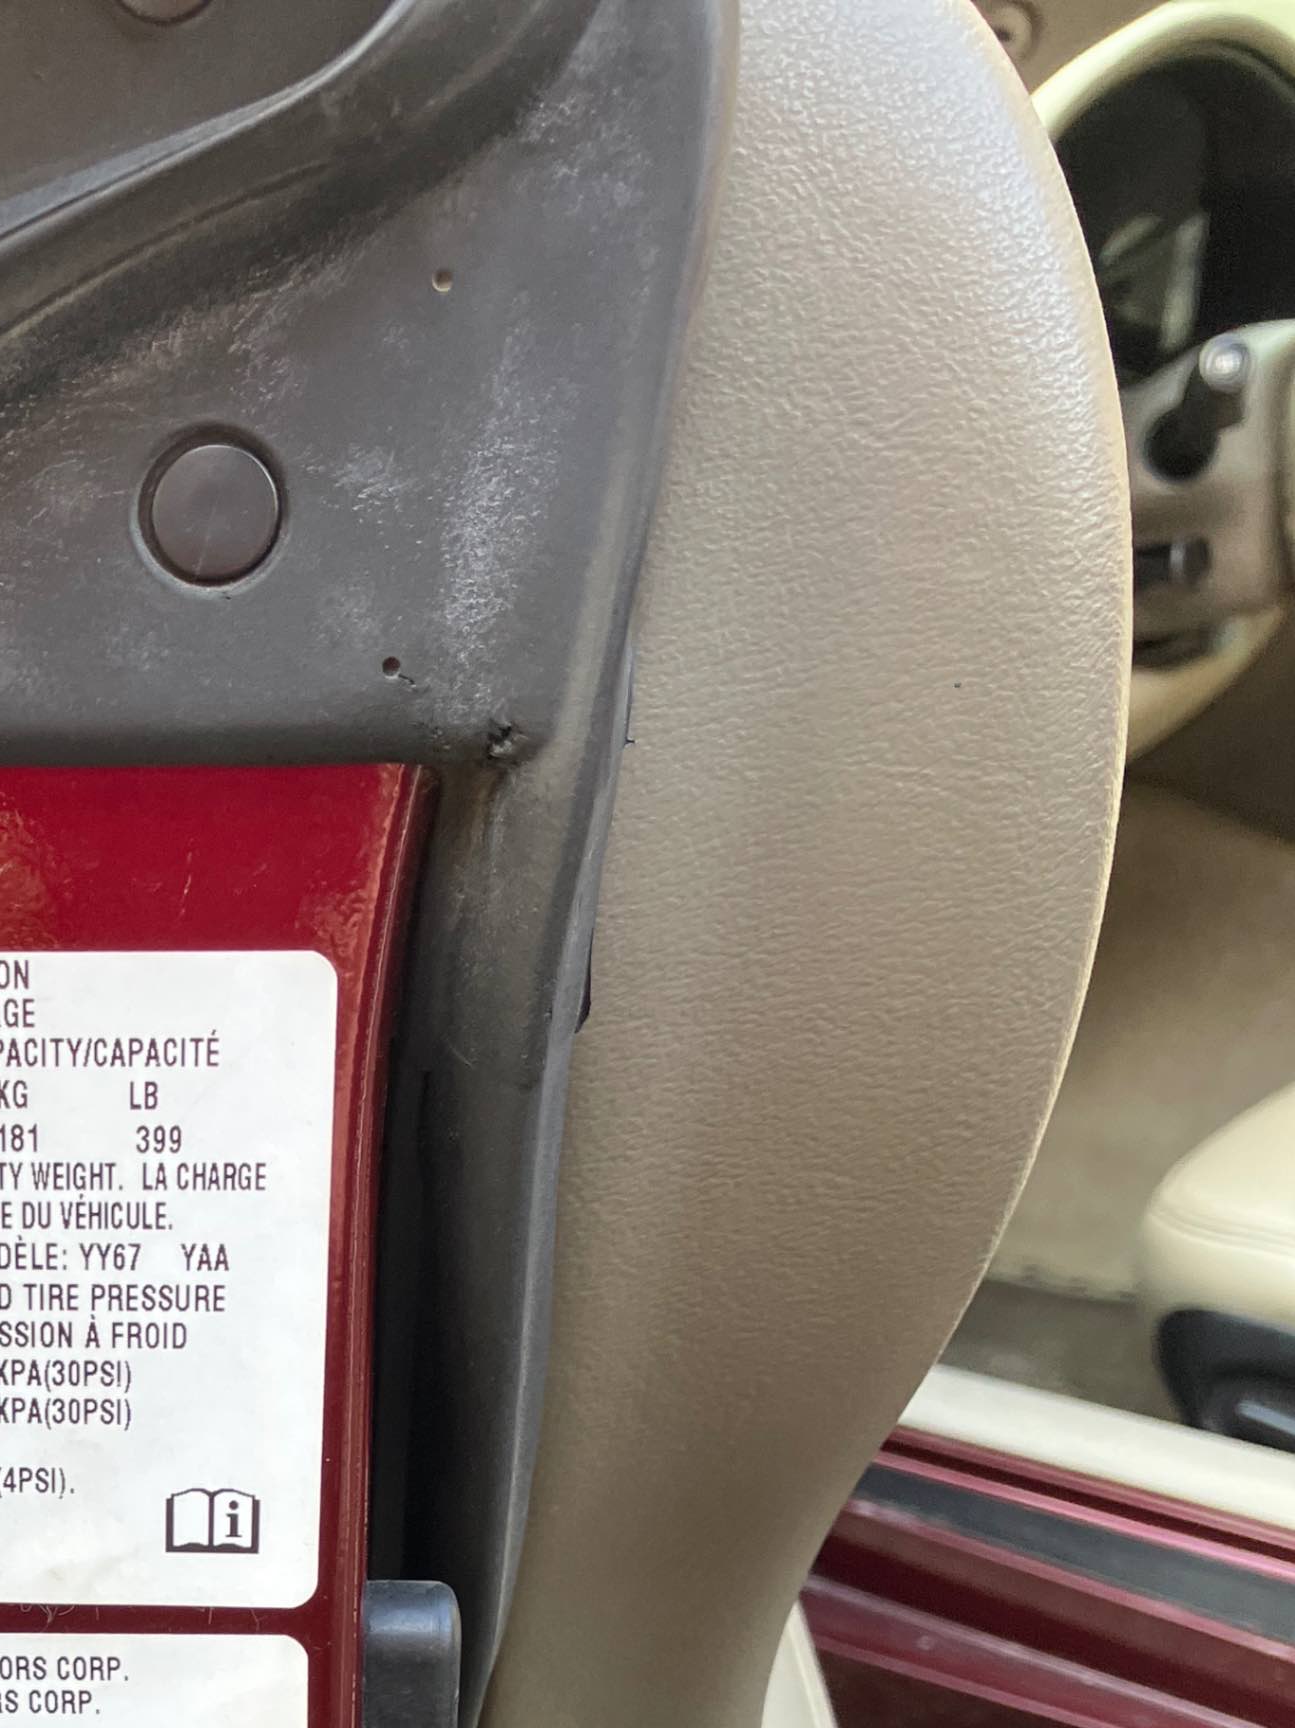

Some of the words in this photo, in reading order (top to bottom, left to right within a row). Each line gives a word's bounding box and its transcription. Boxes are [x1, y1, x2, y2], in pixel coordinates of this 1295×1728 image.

[129, 1080, 159, 1110] LB
[136, 1126, 182, 1153] 399
[32, 1163, 124, 1191] WEIGHT.
[143, 1163, 168, 1190] LA
[177, 1162, 266, 1191] CHARGE
[22, 1202, 51, 1229] DU
[60, 1194, 173, 1230] VÉHICULE.
[79, 1243, 141, 1271] YY67
[181, 1244, 229, 1272] YAA
[24, 1284, 79, 1311] TIRE
[91, 1284, 226, 1312] PRESSURE
[85, 1315, 101, 1349] À
[112, 1321, 187, 1350] FROID
[57, 1657, 129, 1682] CORP.
[29, 1690, 101, 1716] CORP.
